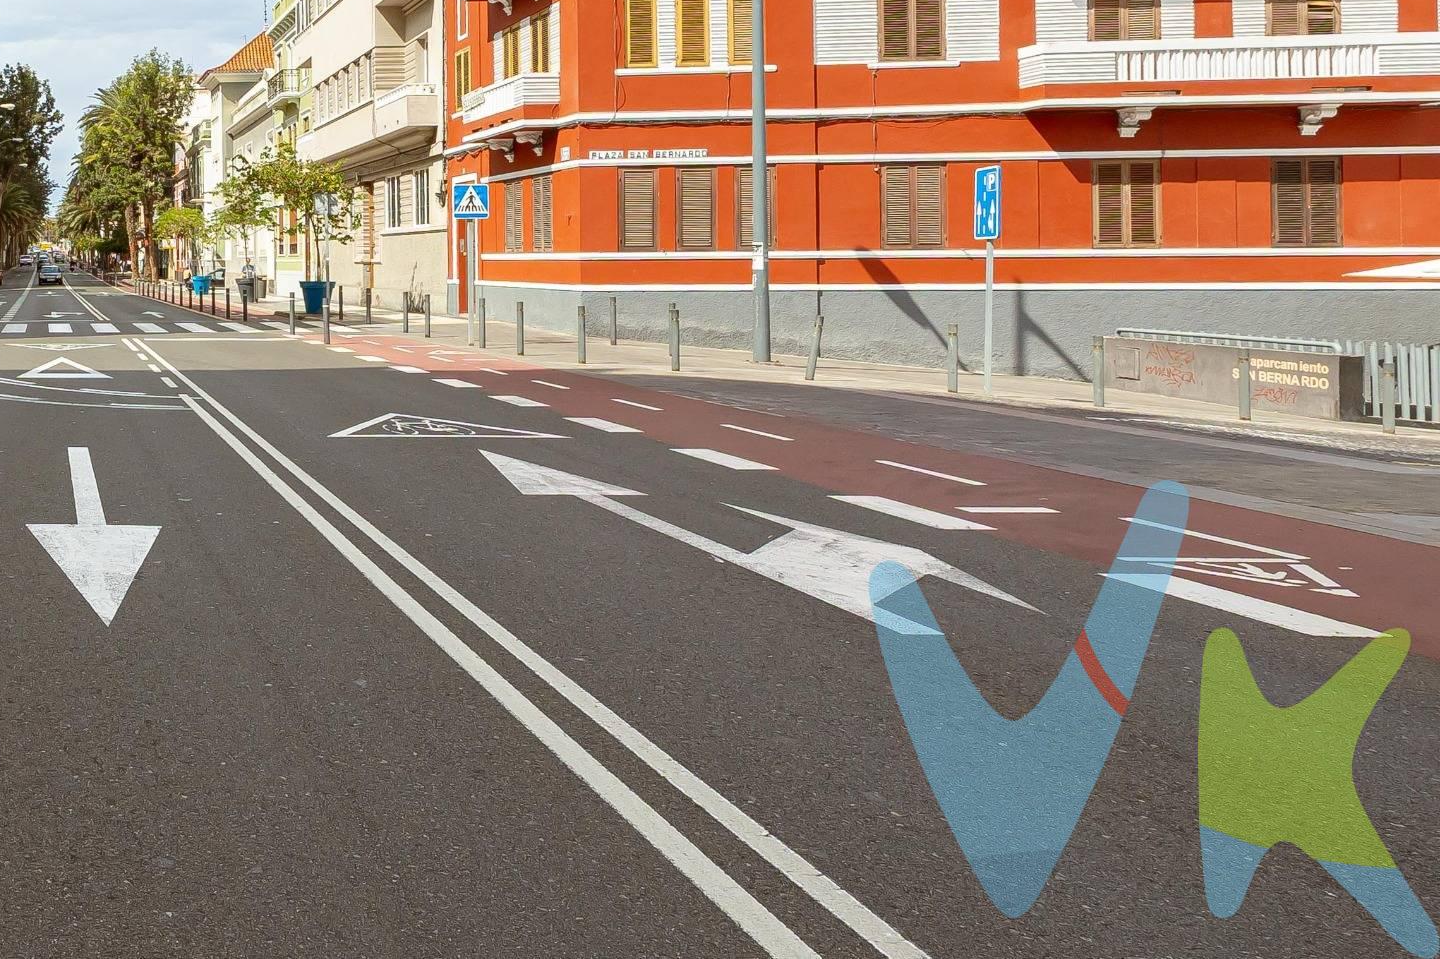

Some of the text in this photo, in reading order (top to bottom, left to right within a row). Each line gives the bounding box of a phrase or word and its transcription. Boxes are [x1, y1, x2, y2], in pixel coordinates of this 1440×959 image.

[590, 149, 708, 160] PLAZA SAN BERNARDO
[1250, 358, 1330, 374] aparcamiento
[1231, 367, 1330, 389] SN BERNARDO
